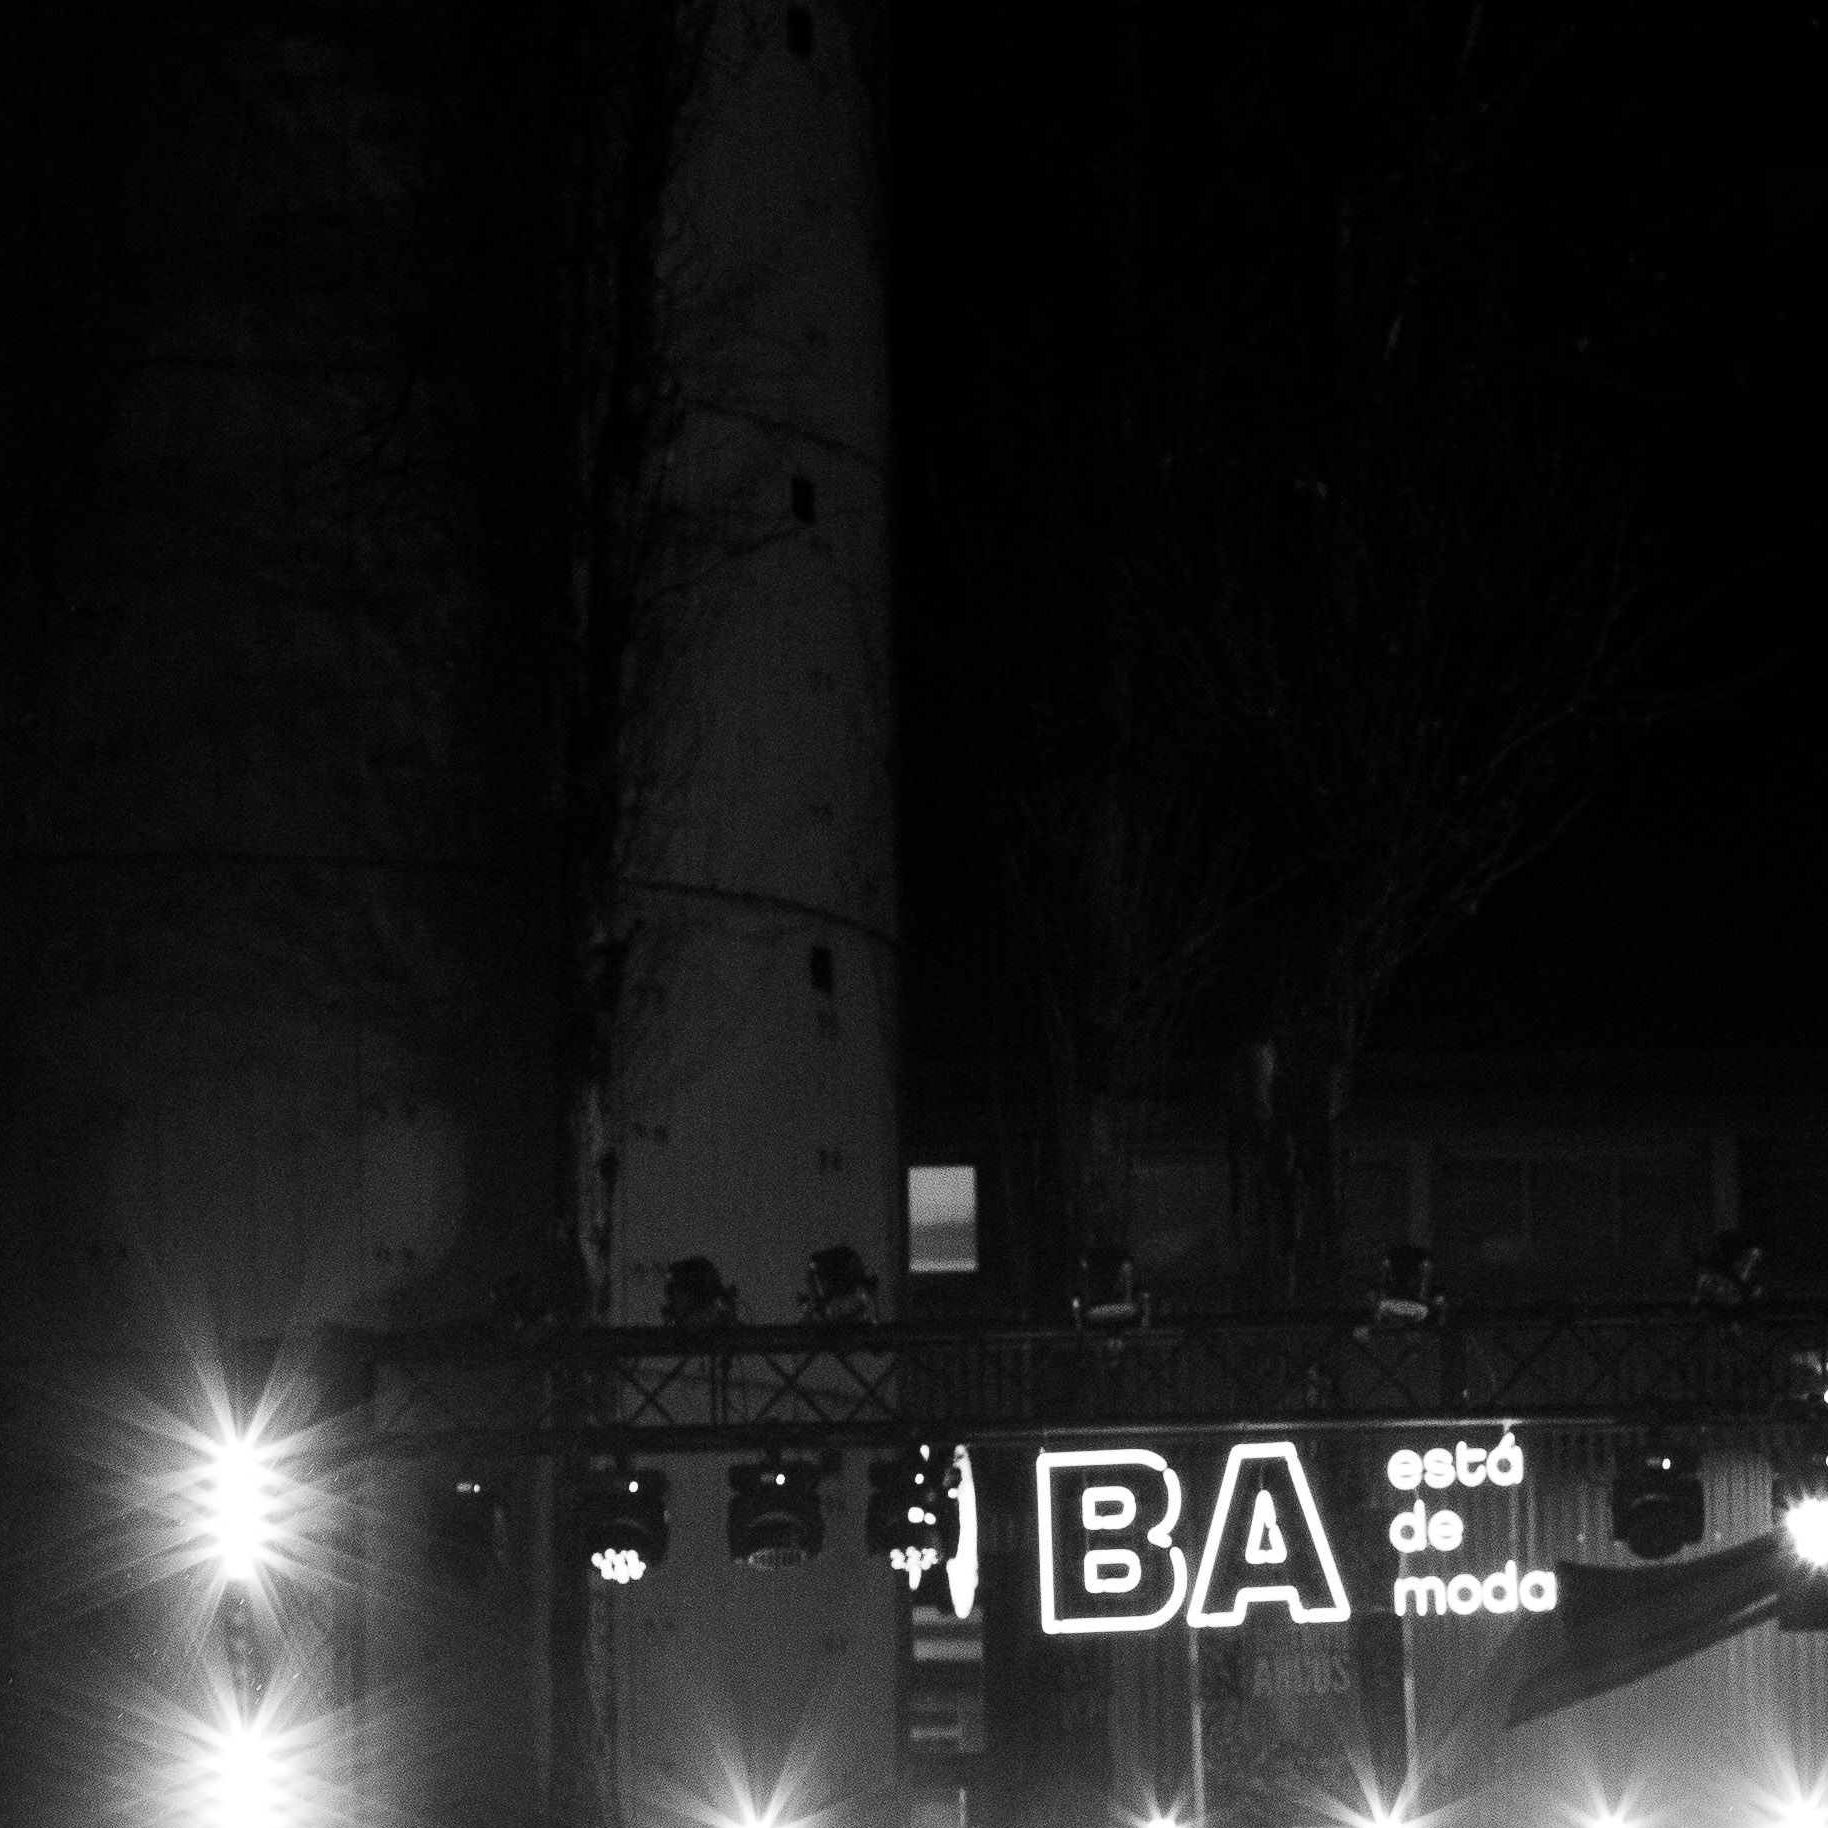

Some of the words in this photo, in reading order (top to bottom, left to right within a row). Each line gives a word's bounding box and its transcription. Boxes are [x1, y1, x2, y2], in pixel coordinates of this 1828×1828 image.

[1386, 1432, 1524, 1490] está
[1035, 1440, 1352, 1635] BA
[1388, 1499, 1465, 1552] de
[1393, 1560, 1558, 1617] moda
